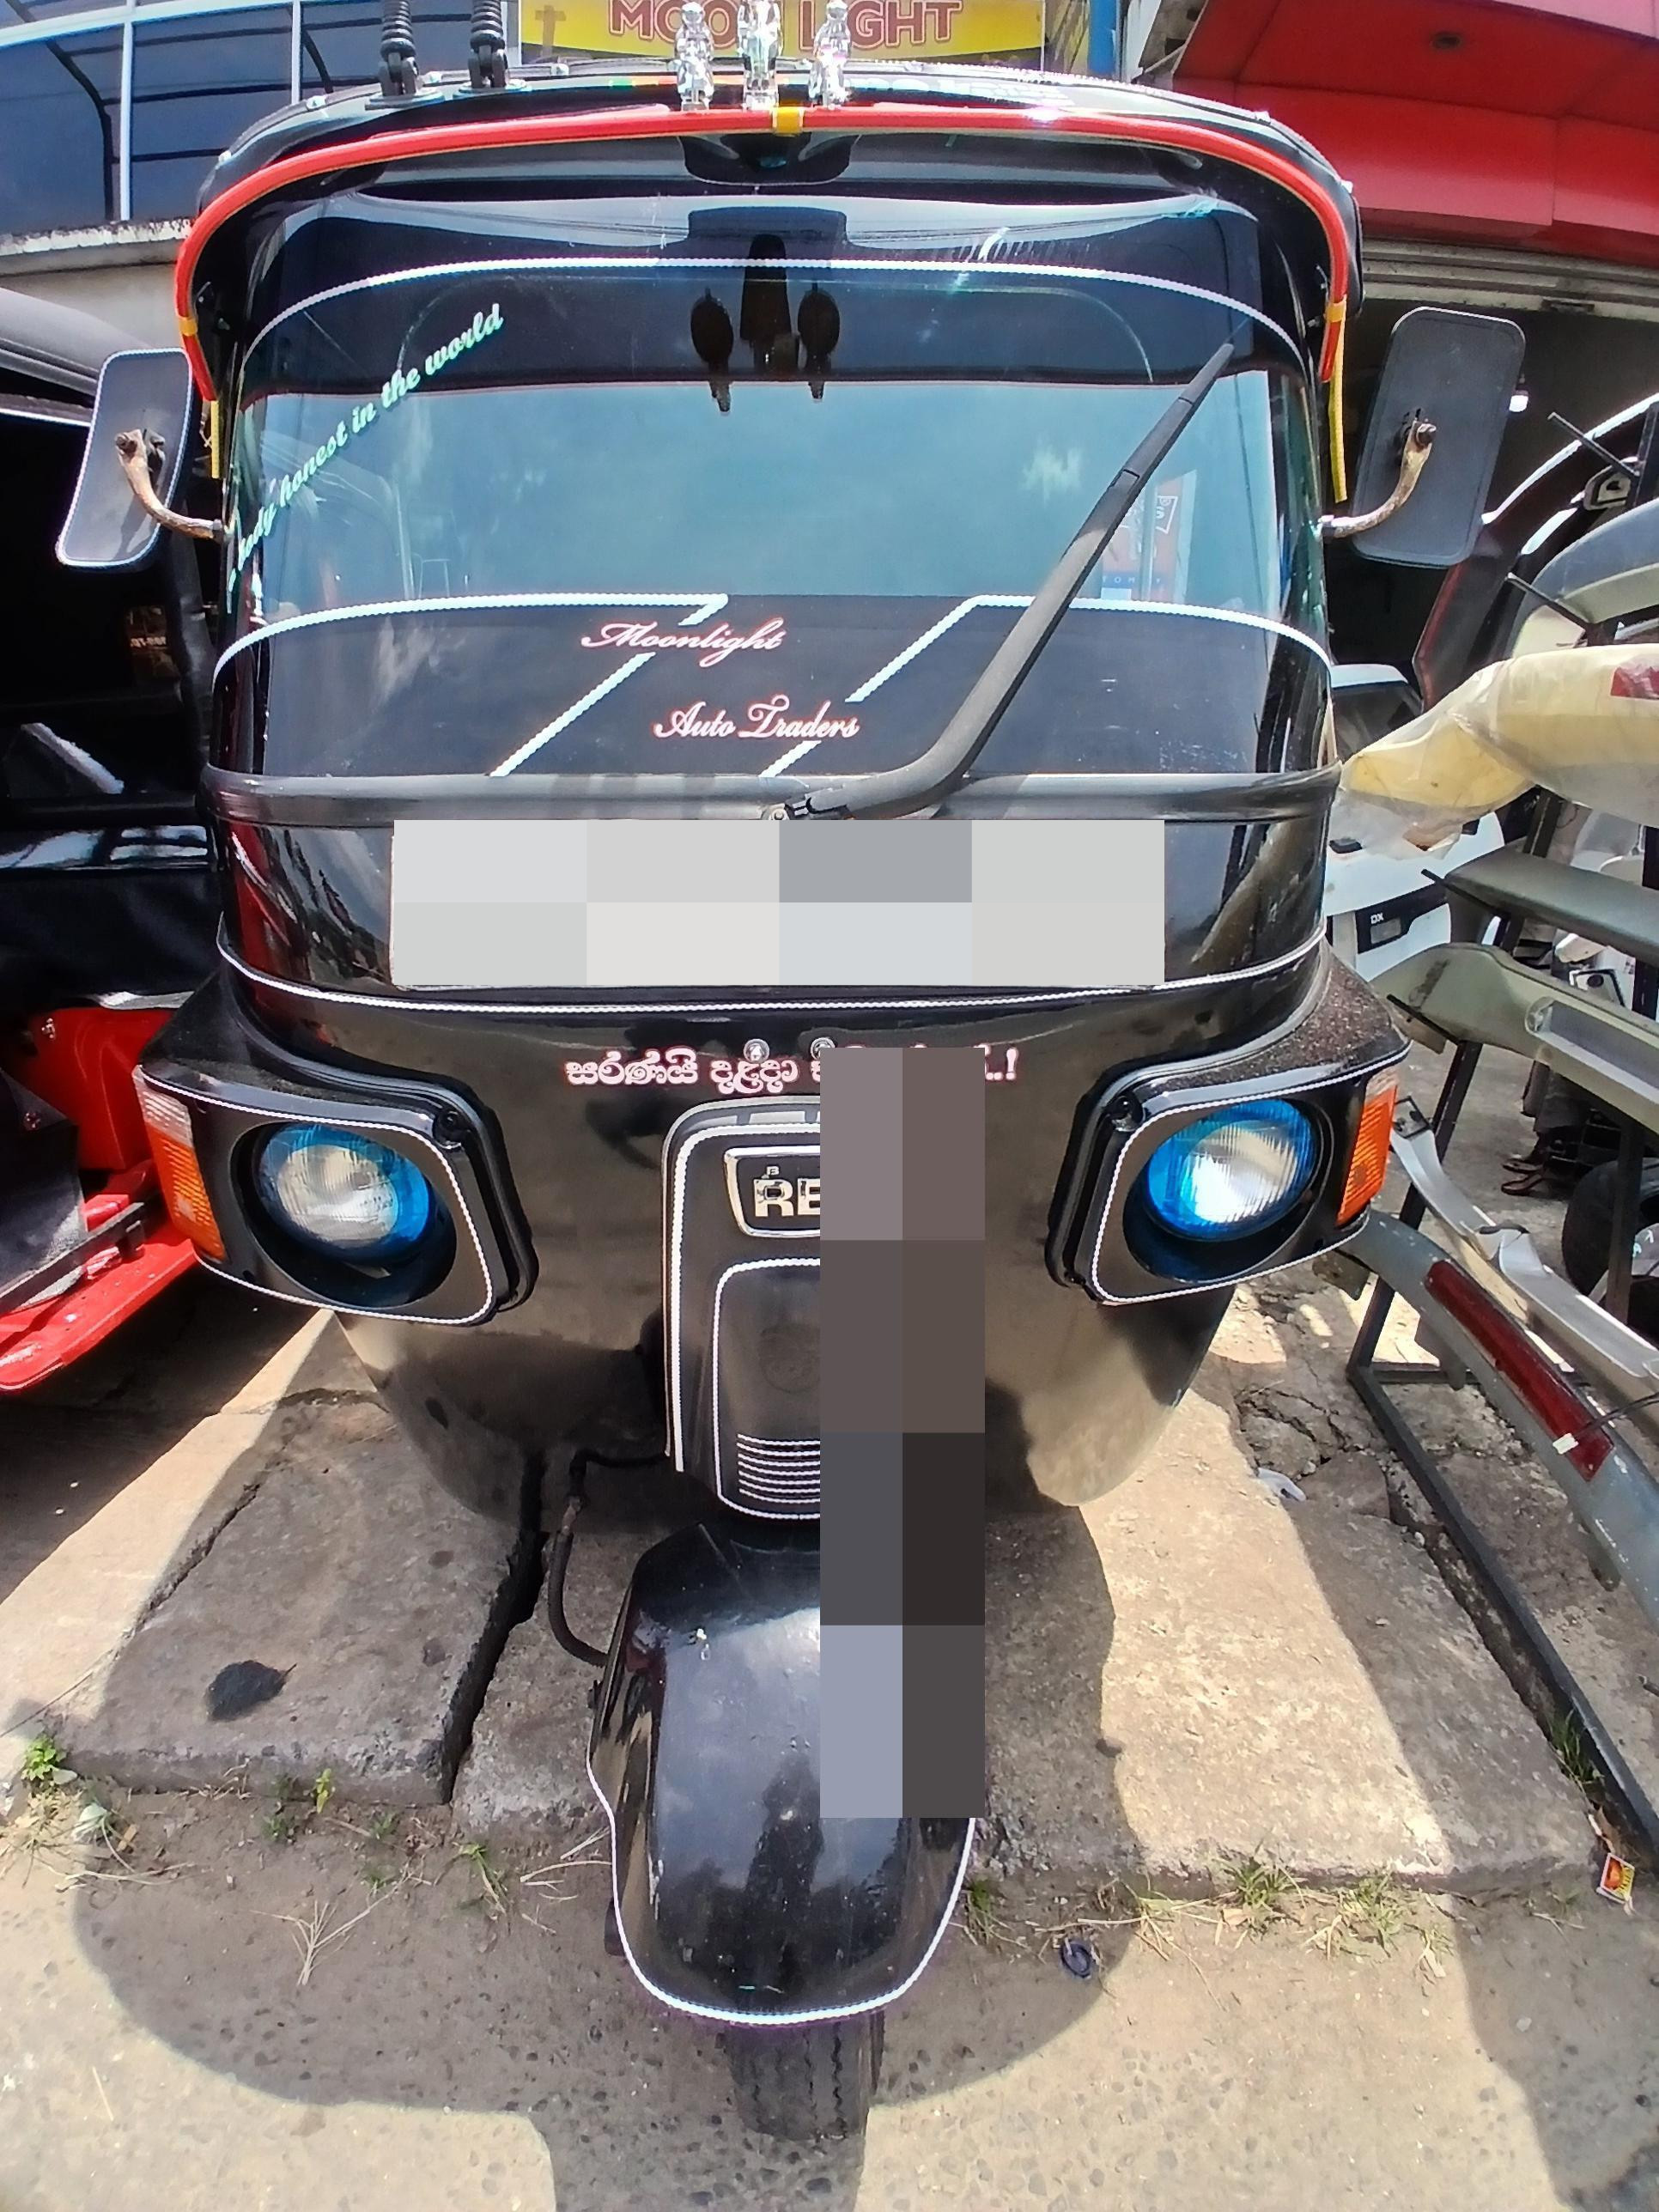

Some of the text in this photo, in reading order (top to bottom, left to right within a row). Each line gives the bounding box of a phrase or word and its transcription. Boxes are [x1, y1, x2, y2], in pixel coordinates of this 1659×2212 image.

[279, 421, 349, 508] honest
[351, 401, 377, 434] in
[380, 368, 422, 409] the
[424, 303, 505, 377] world
[580, 617, 787, 668] Moonlight
[653, 693, 861, 739] Auto Traders
